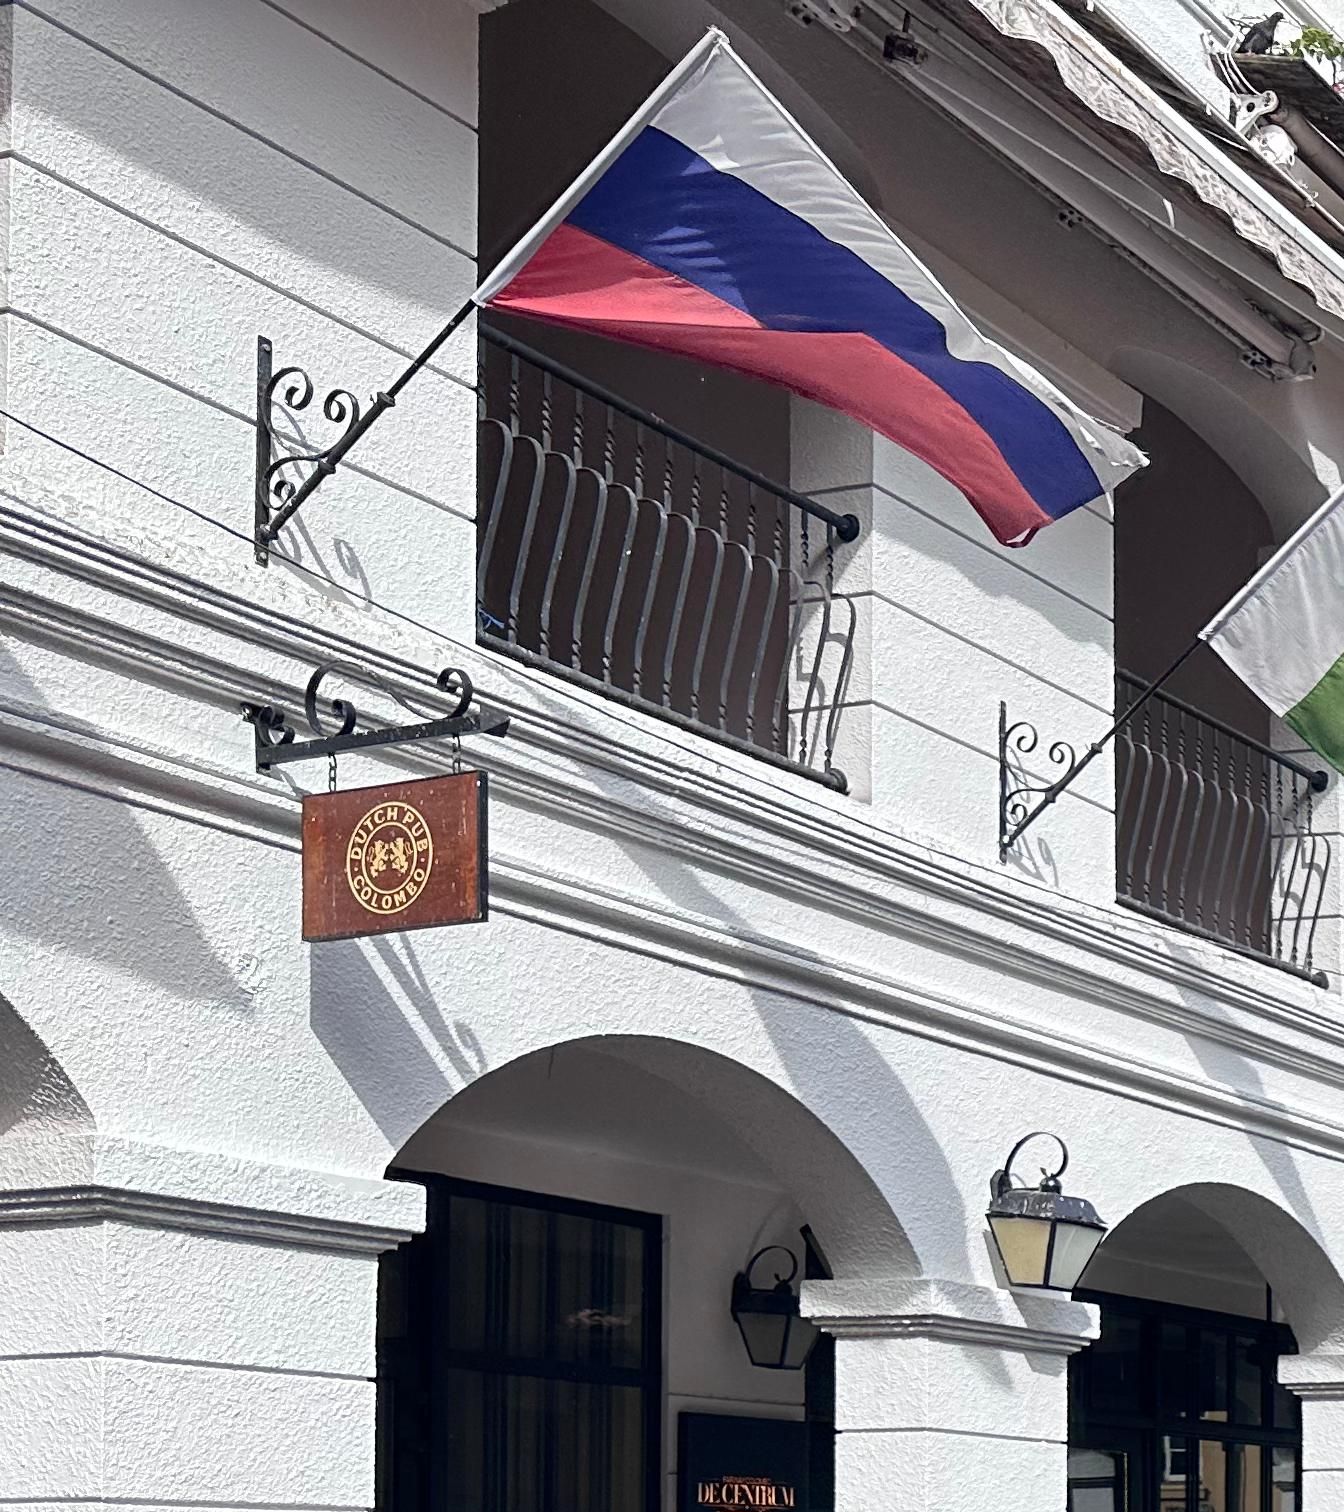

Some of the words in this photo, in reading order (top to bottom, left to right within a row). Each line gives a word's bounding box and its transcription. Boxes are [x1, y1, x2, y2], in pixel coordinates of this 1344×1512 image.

[350, 807, 398, 860] DUTCH
[402, 811, 429, 852] PUB
[353, 868, 425, 909] COLOMBO
[697, 1483, 721, 1503] DE
[721, 1484, 795, 1506] CENTRUM
